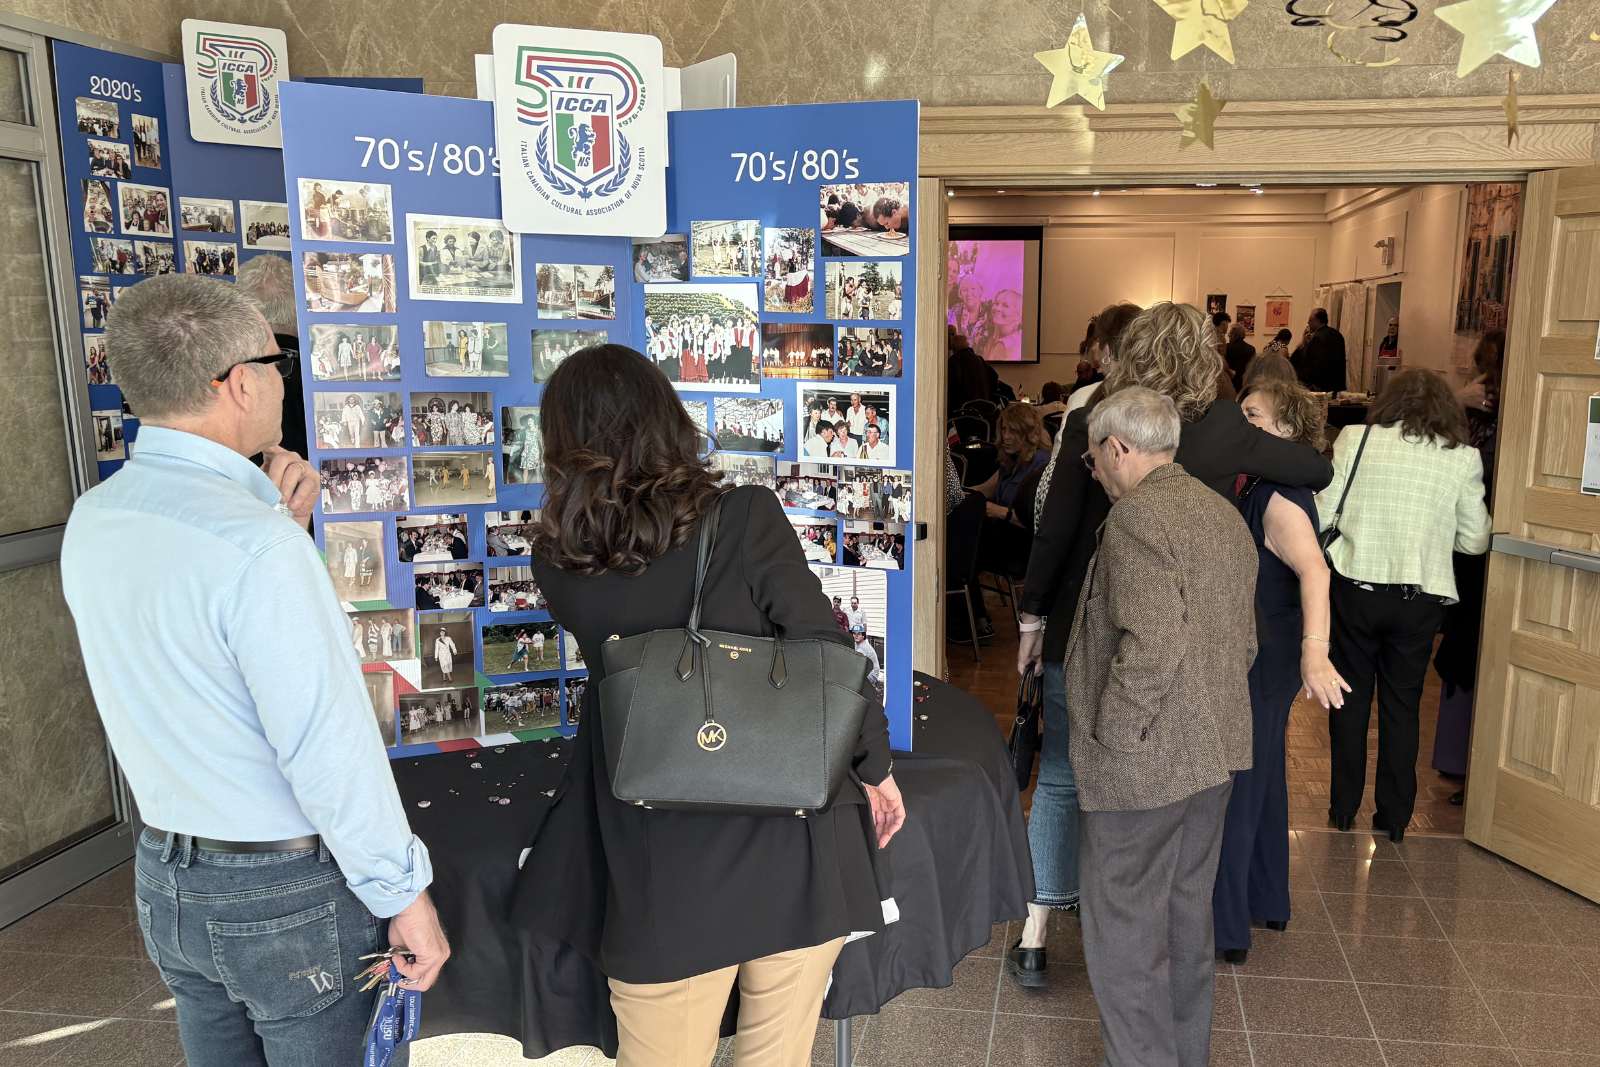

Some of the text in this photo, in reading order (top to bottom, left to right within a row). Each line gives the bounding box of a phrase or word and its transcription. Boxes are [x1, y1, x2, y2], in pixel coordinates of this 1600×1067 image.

[221, 62, 254, 73] ICCA
[90, 75, 142, 102] 2020's
[555, 96, 607, 112] ICCA
[618, 86, 647, 127] 1976-2026
[577, 156, 591, 167] NS
[731, 149, 860, 184] 70's/80's
[520, 140, 646, 216] ITALIAN CANADIAN CULTURAL ASSOCIATION OF NOVA SCOTIA
